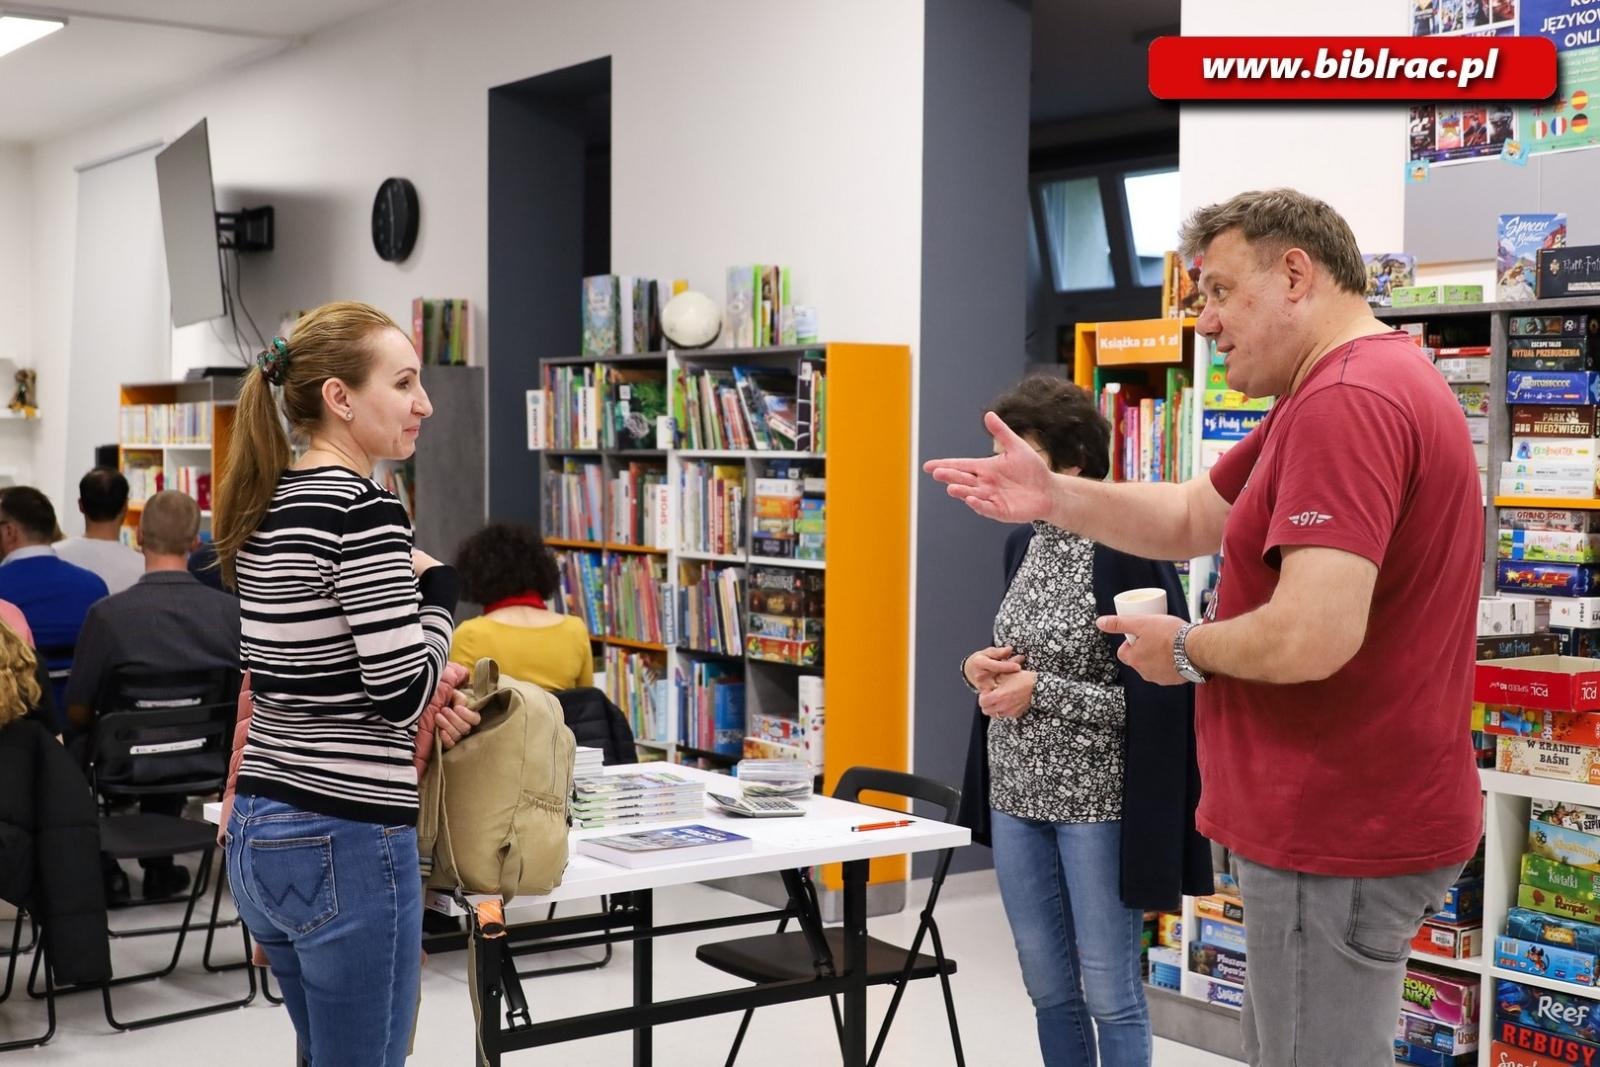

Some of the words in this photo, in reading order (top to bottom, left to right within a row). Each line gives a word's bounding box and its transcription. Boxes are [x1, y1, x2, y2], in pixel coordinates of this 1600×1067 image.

[1540, 8, 1600, 34] JĘZYKO
[1143, 338, 1156, 347] za
[1160, 334, 1165, 346] 1
[1543, 412, 1566, 422] PARK
[660, 489, 669, 525] SPORT
[1300, 511, 1318, 526] 97
[1517, 511, 1545, 519] GRAND
[1548, 512, 1567, 520] PRIX
[1527, 739, 1536, 748] W
[1539, 742, 1581, 754] KRAINIE
[1540, 753, 1569, 765] BAŚNI
[1537, 995, 1589, 1026] Reef
[1502, 1023, 1597, 1067] REBUSY
